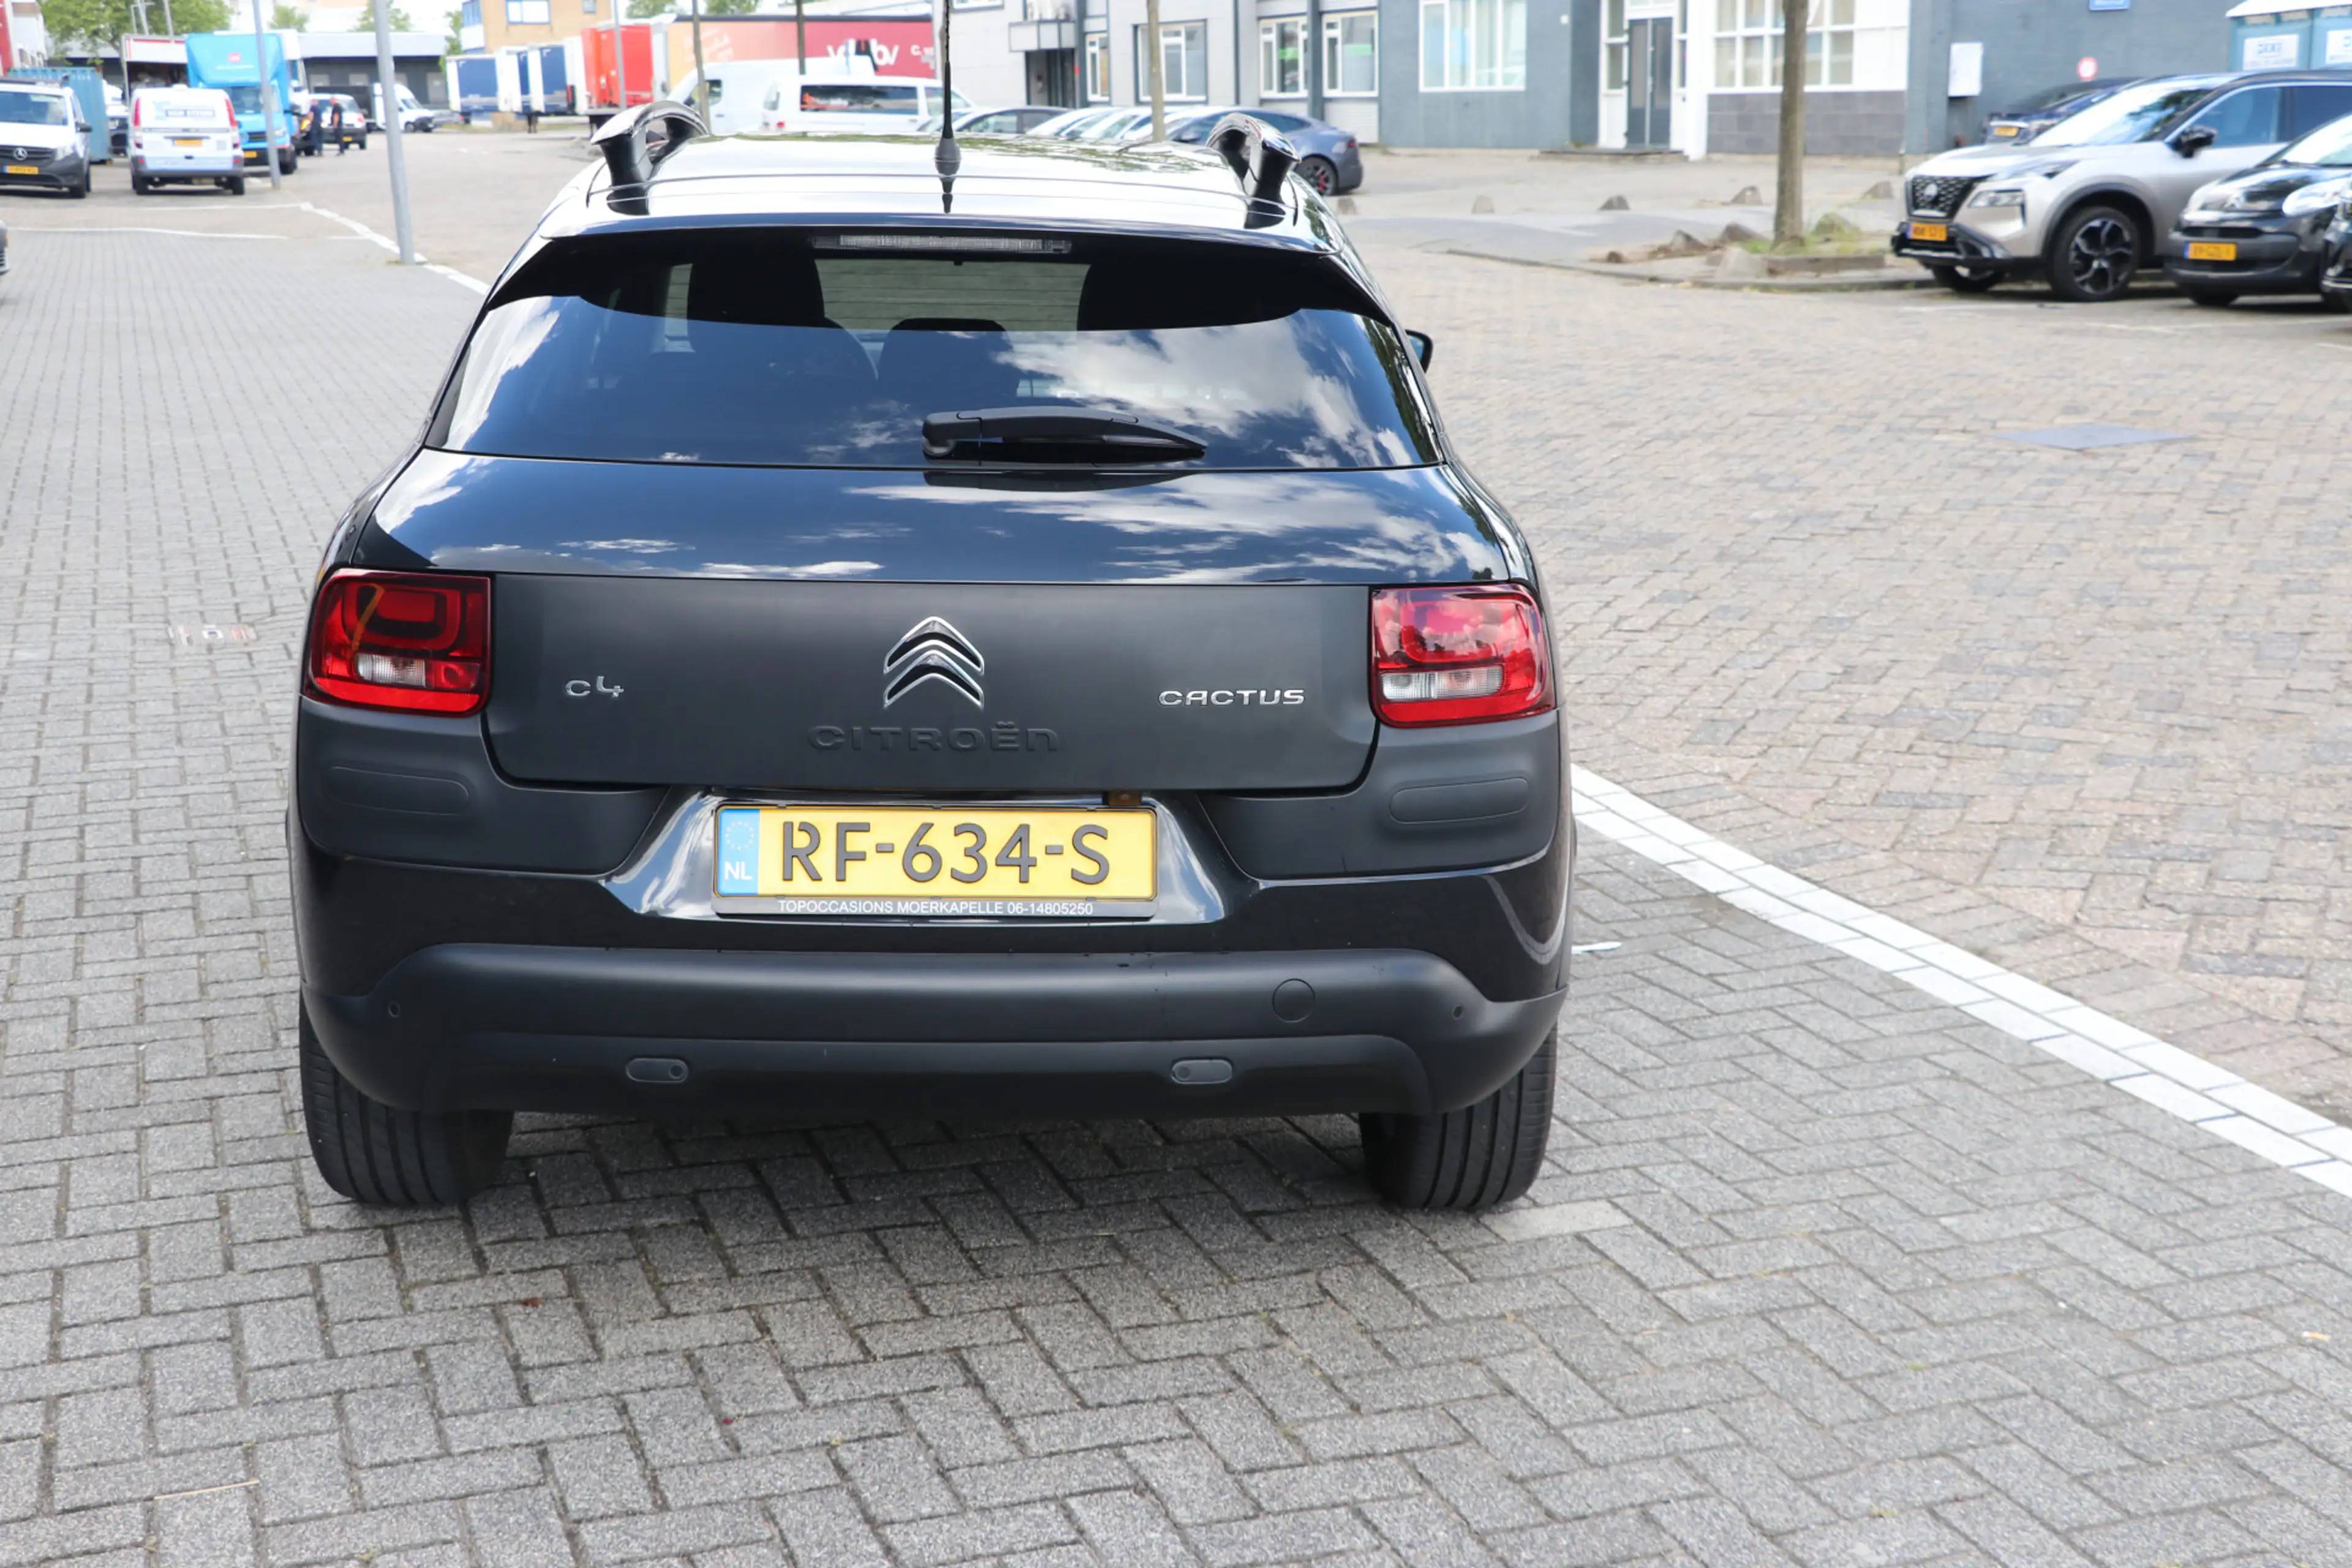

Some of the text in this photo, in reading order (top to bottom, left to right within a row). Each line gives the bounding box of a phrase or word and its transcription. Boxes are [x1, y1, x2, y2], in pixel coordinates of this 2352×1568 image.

[565, 676, 625, 698] C4
[1158, 690, 1305, 706] CACTUS
[782, 821, 1110, 884] RF-634-S
[725, 861, 753, 880] NL
[778, 900, 1094, 915] TOPOCCASIONS MOERKAPELLE 06-14805250
